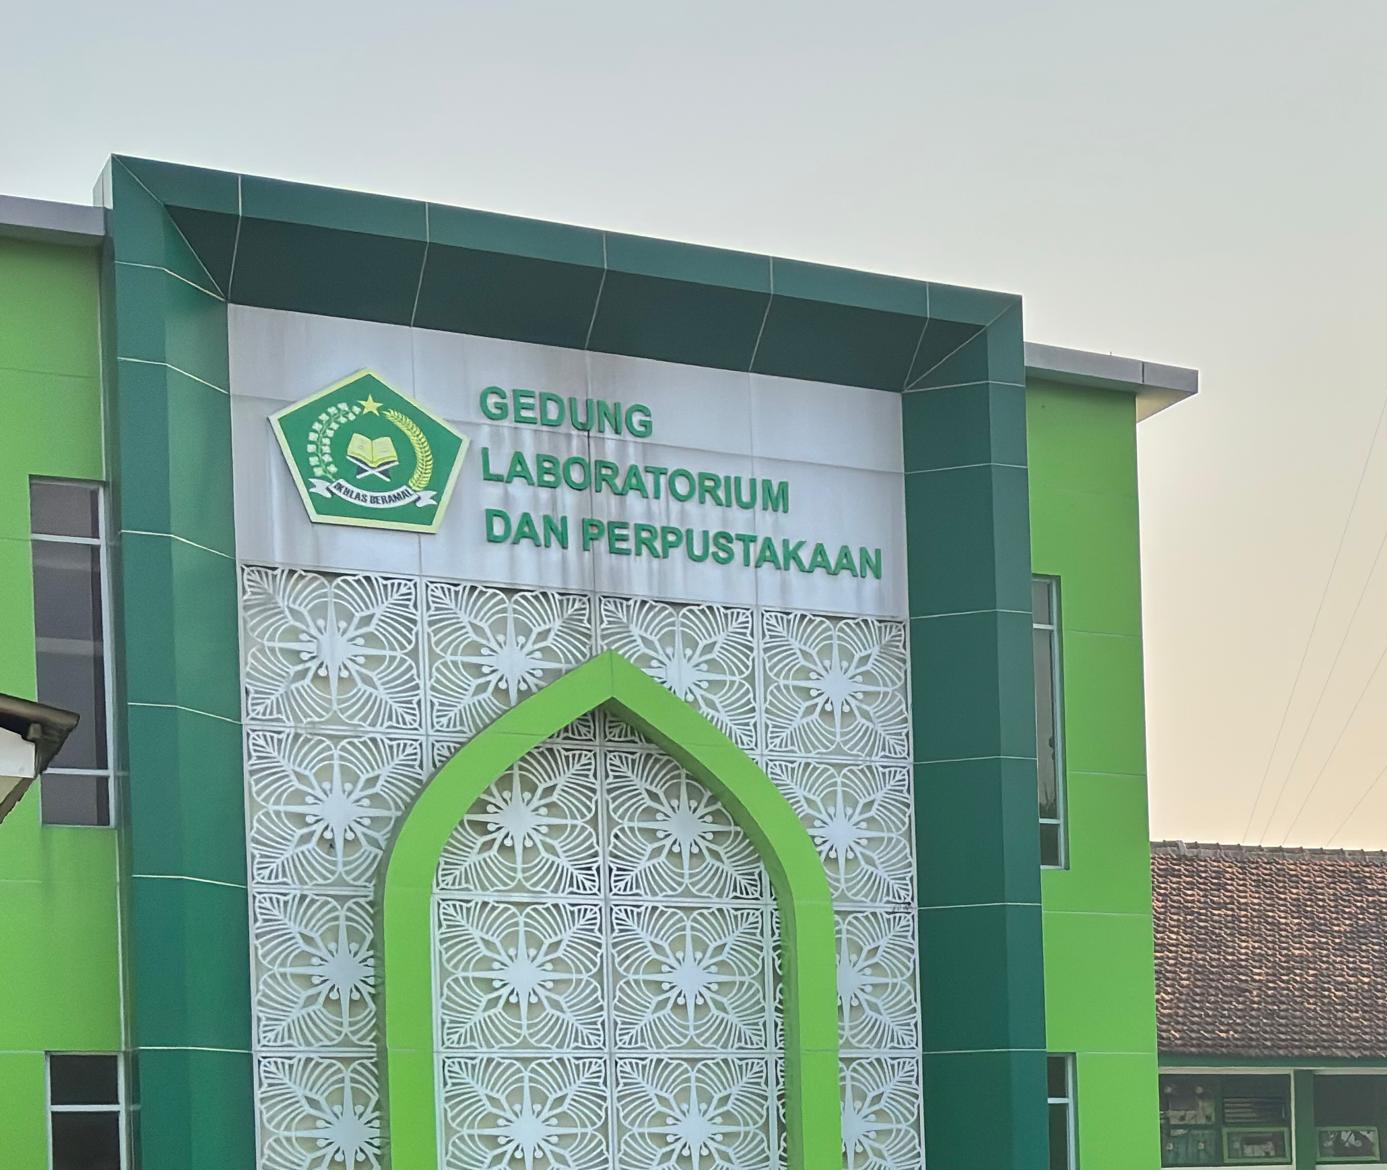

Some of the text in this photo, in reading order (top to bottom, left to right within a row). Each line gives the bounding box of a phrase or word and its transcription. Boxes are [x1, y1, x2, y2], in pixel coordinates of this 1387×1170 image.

[480, 385, 654, 439] GEDUNG
[480, 447, 790, 513] LABORATORIUM
[484, 508, 883, 580] DAN PERPUSTAKAAN
